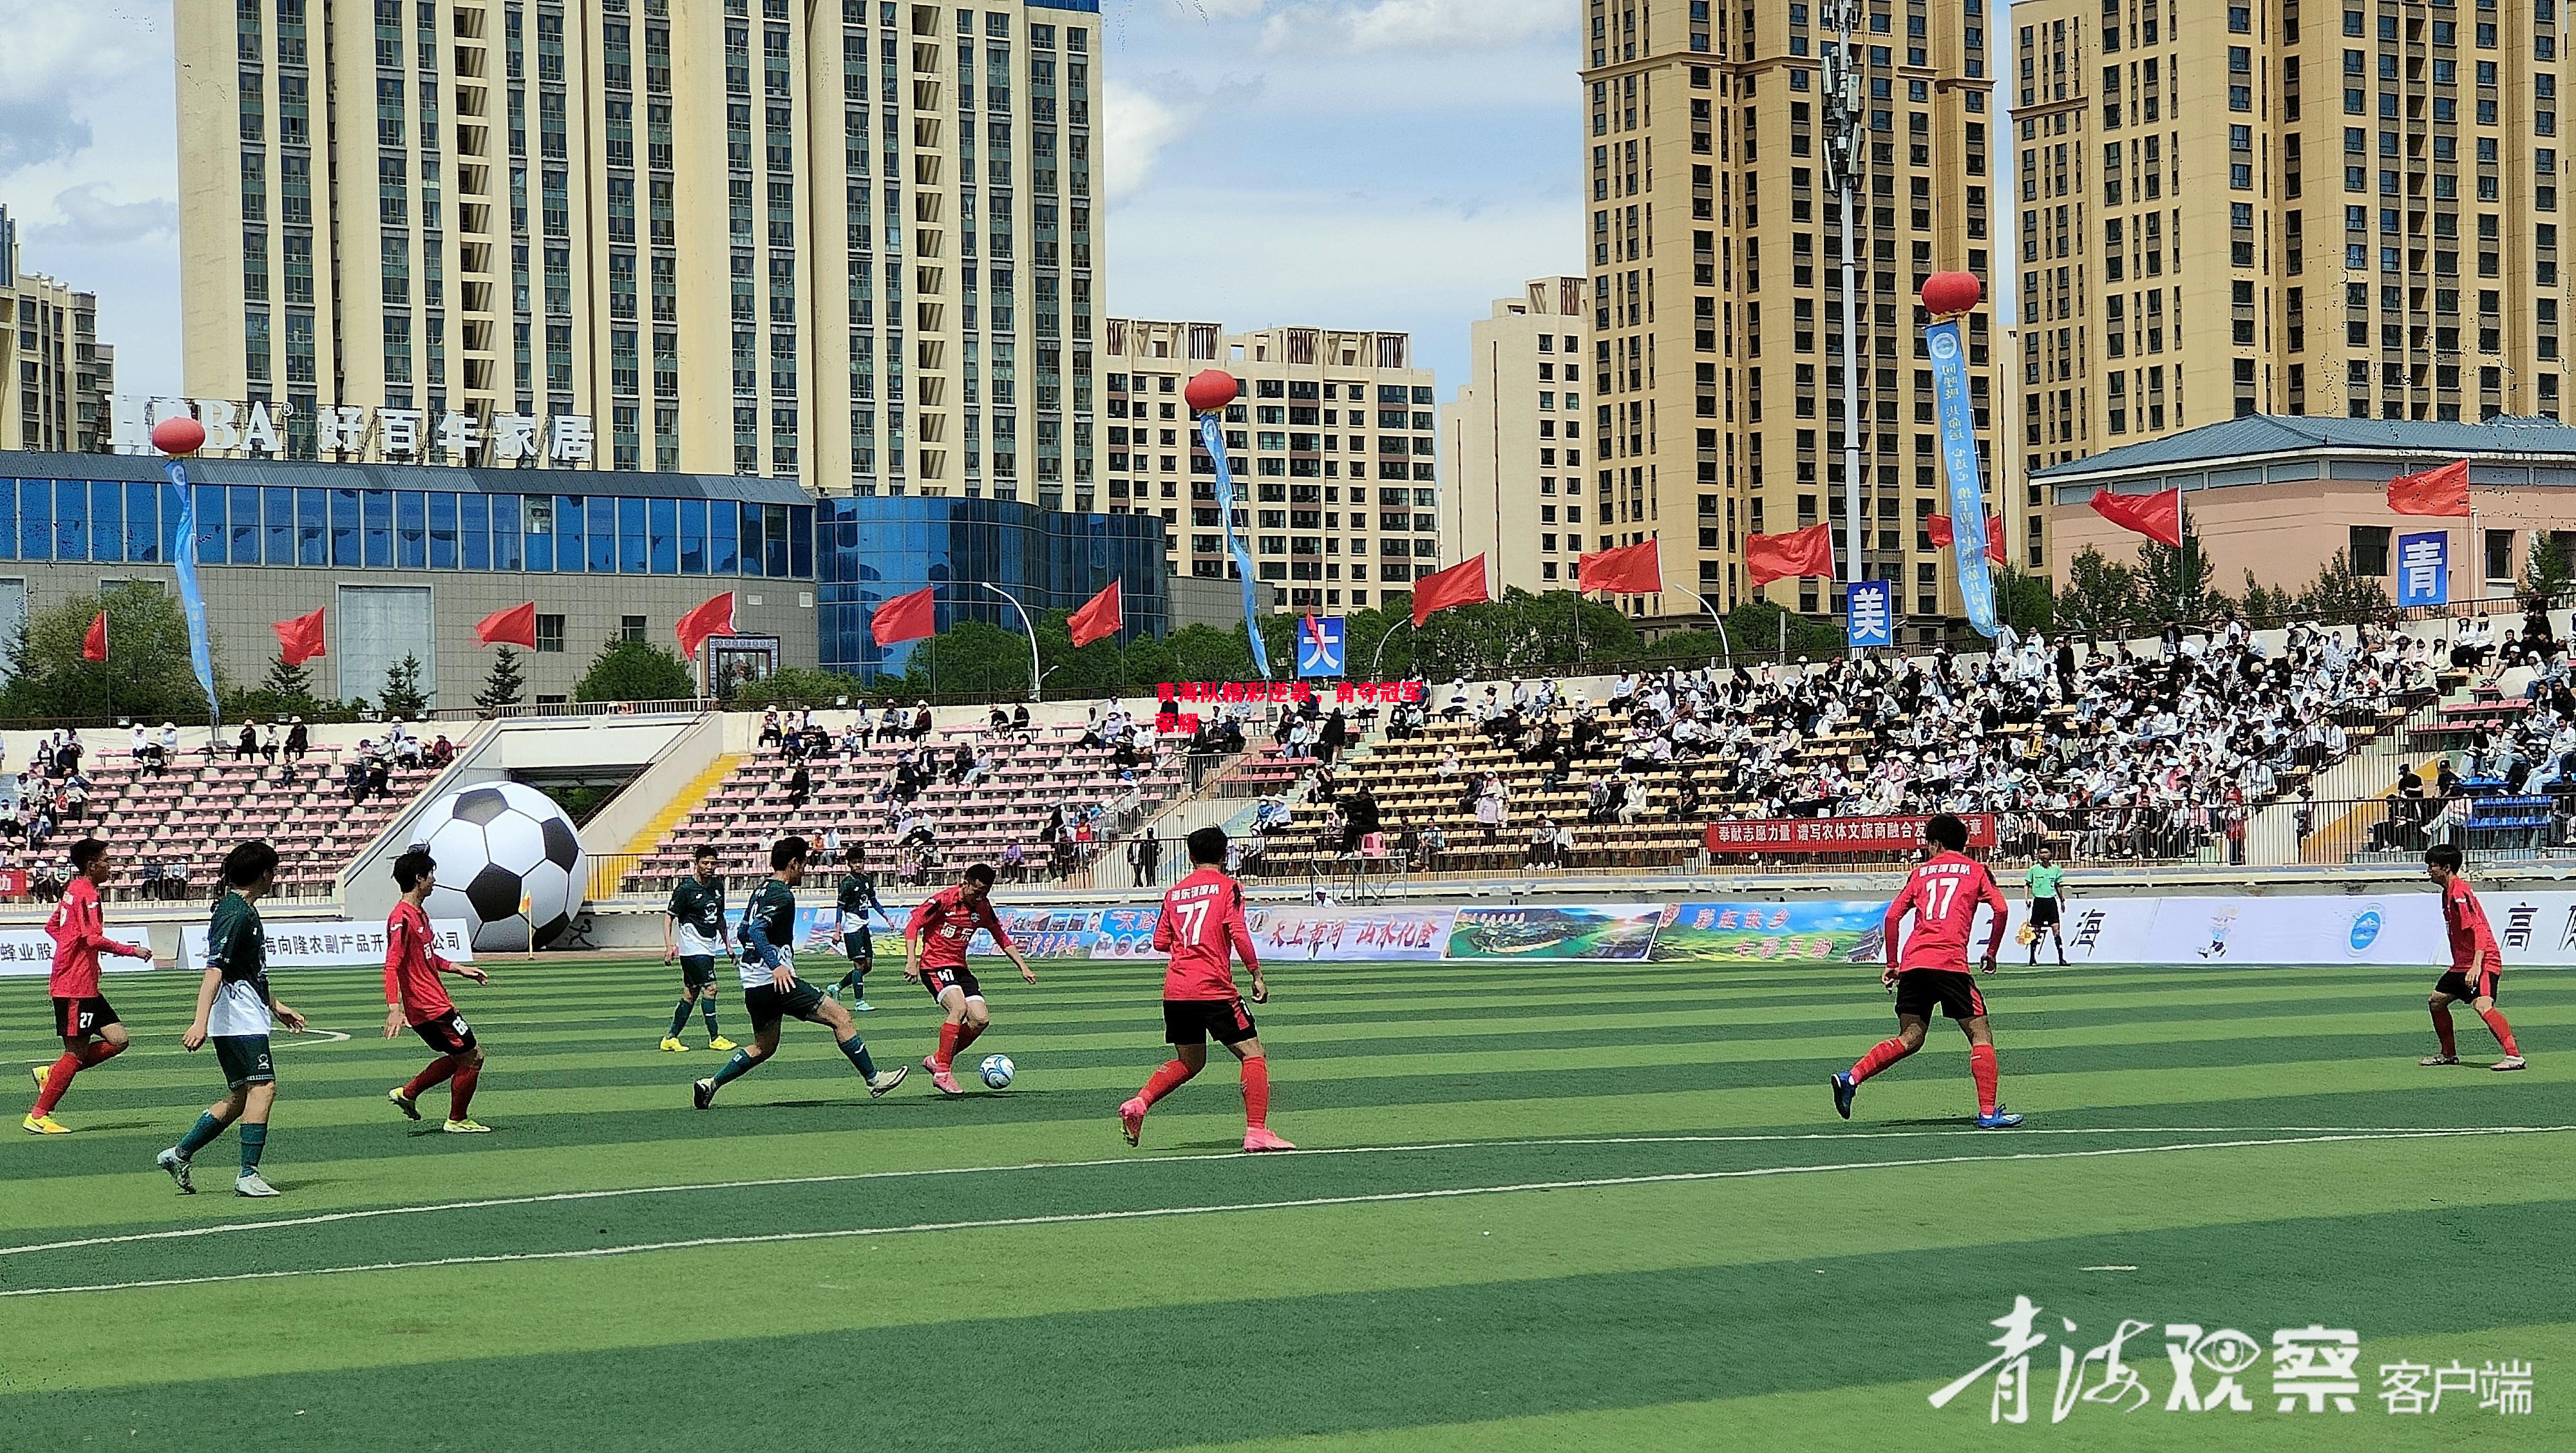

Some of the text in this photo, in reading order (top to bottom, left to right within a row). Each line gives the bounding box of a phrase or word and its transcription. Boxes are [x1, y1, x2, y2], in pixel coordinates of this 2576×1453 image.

[320, 405, 594, 462] 好百年家居
[2403, 540, 2443, 598] 青
[1853, 587, 1886, 640] 美
[1302, 623, 1340, 670] 大
[1718, 819, 1983, 842] 奉献志愿力量 谱写农体文旅商融合发章
[1926, 877, 1960, 920] 17
[1177, 899, 1211, 949] 77
[2070, 909, 2106, 957] 海
[937, 969, 955, 982] 47
[79, 1012, 94, 1029] 27
